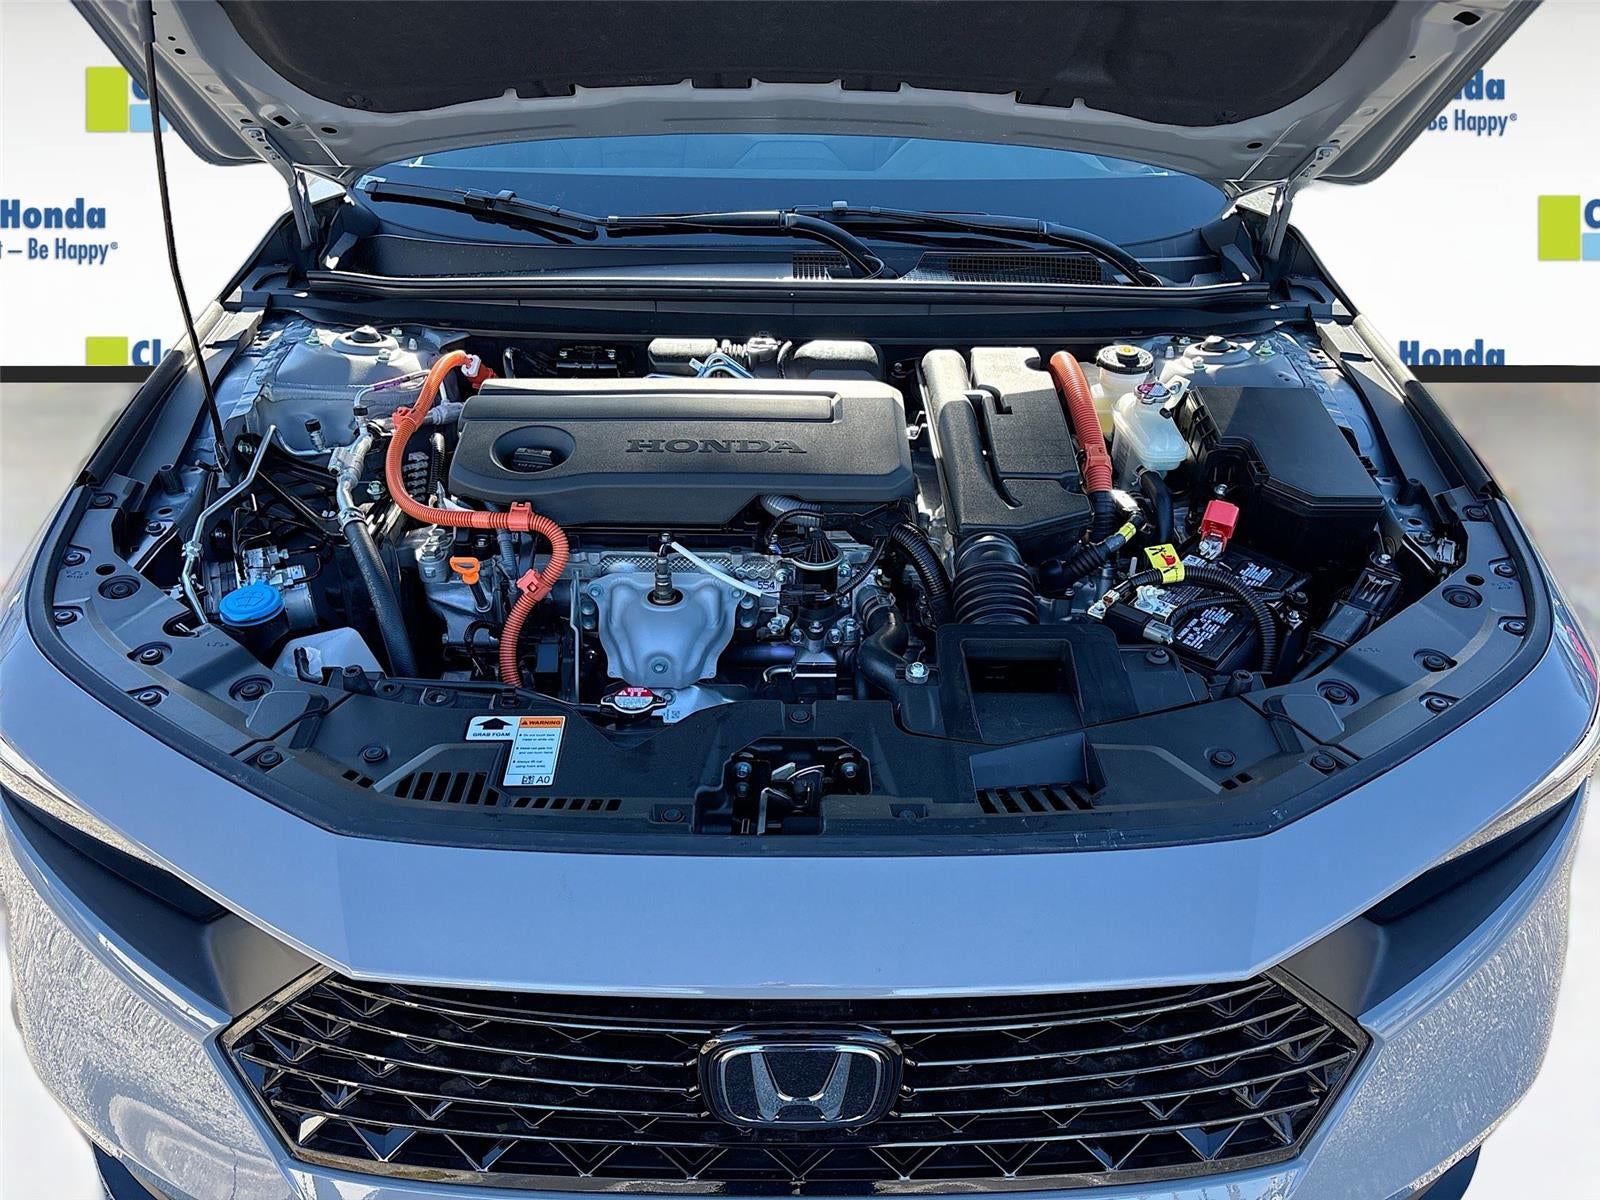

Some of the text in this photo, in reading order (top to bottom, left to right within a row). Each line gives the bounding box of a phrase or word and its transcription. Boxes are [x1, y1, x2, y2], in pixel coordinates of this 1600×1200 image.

[0, 197, 106, 229] Honda
[28, 237, 49, 260] Be
[625, 439, 807, 454] HONDA
